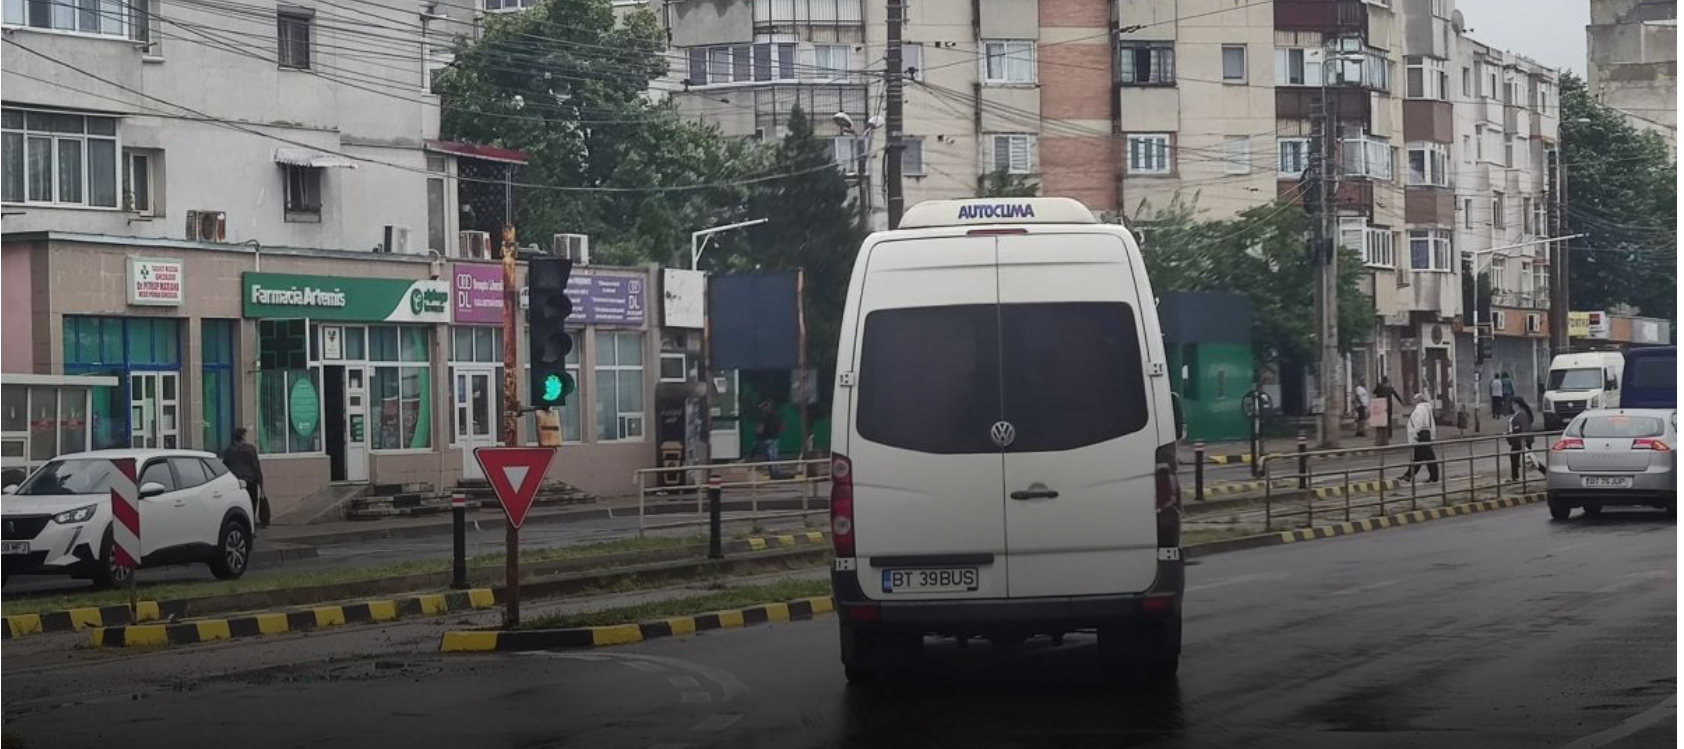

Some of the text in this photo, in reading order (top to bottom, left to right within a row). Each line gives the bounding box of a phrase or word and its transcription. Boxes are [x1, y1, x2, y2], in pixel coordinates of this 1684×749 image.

[958, 204, 1034, 219] AUTOCLIMA
[251, 285, 346, 307] Farmacia Artemis
[458, 291, 472, 308] DL
[629, 295, 640, 309] DL
[892, 571, 913, 587] BT
